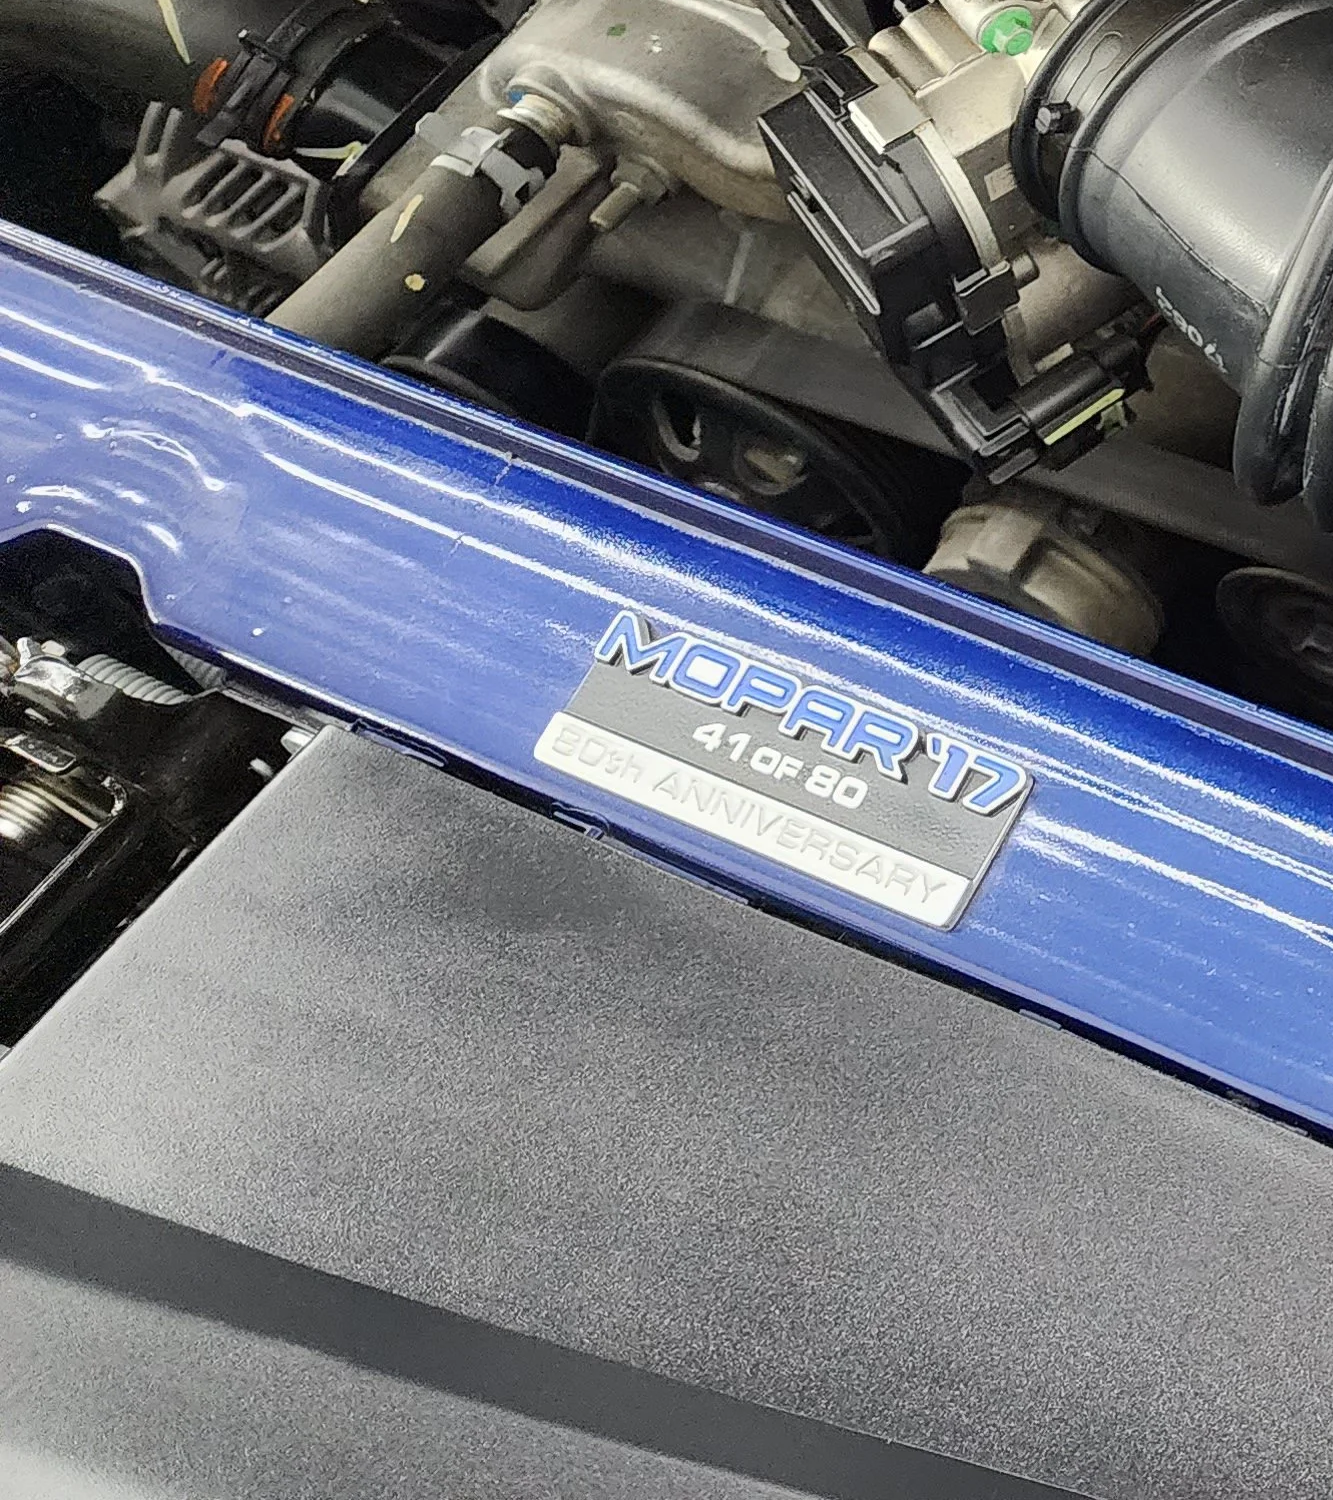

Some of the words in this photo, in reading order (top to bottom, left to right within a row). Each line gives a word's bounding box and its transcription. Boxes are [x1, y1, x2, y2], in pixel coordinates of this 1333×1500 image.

[594, 610, 920, 784] MOPAR
[692, 722, 752, 763] 41
[750, 745, 804, 780] OF
[804, 764, 869, 810] 80
[651, 771, 948, 904] ANNIVERSARY
